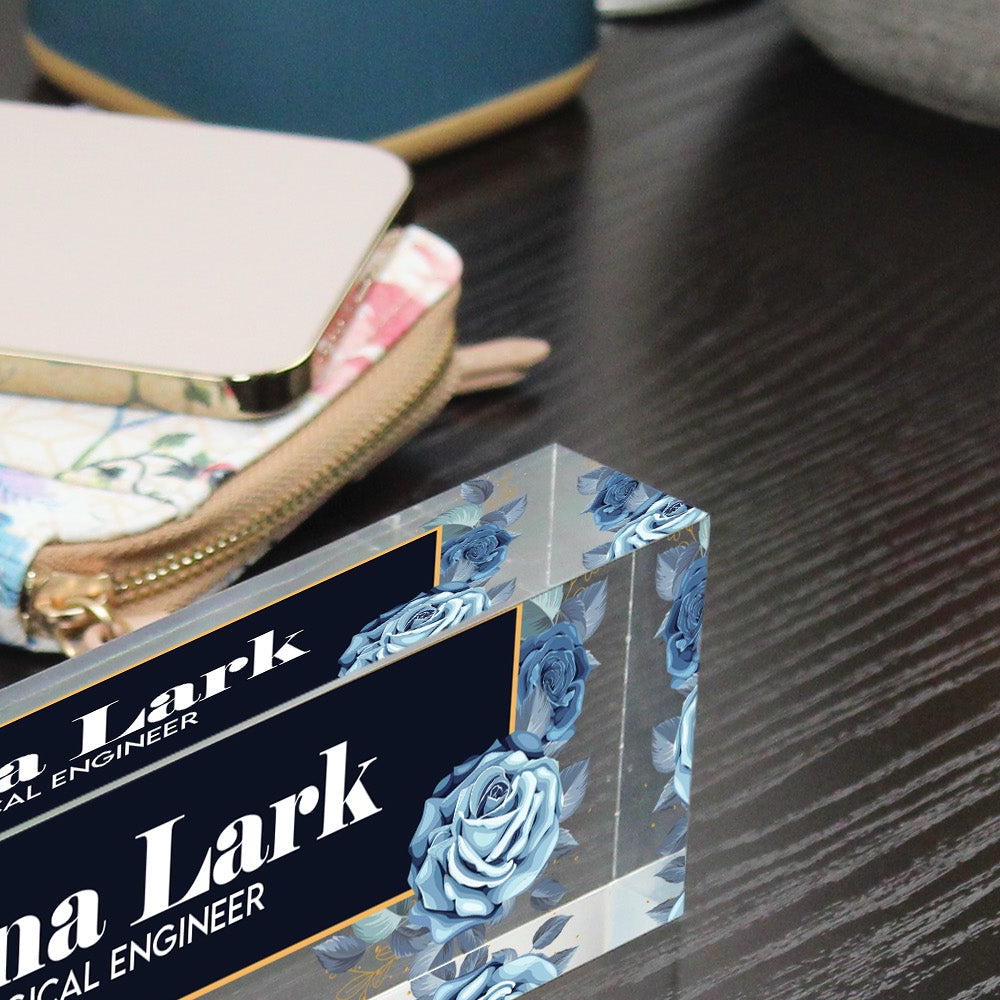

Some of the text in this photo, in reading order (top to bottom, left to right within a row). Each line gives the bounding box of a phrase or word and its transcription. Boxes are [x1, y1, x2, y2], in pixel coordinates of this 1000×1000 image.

[51, 711, 199, 790] ENGINEER
[69, 629, 311, 762] Lark
[130, 740, 383, 927] Lark
[110, 882, 265, 981] ENGINEER
